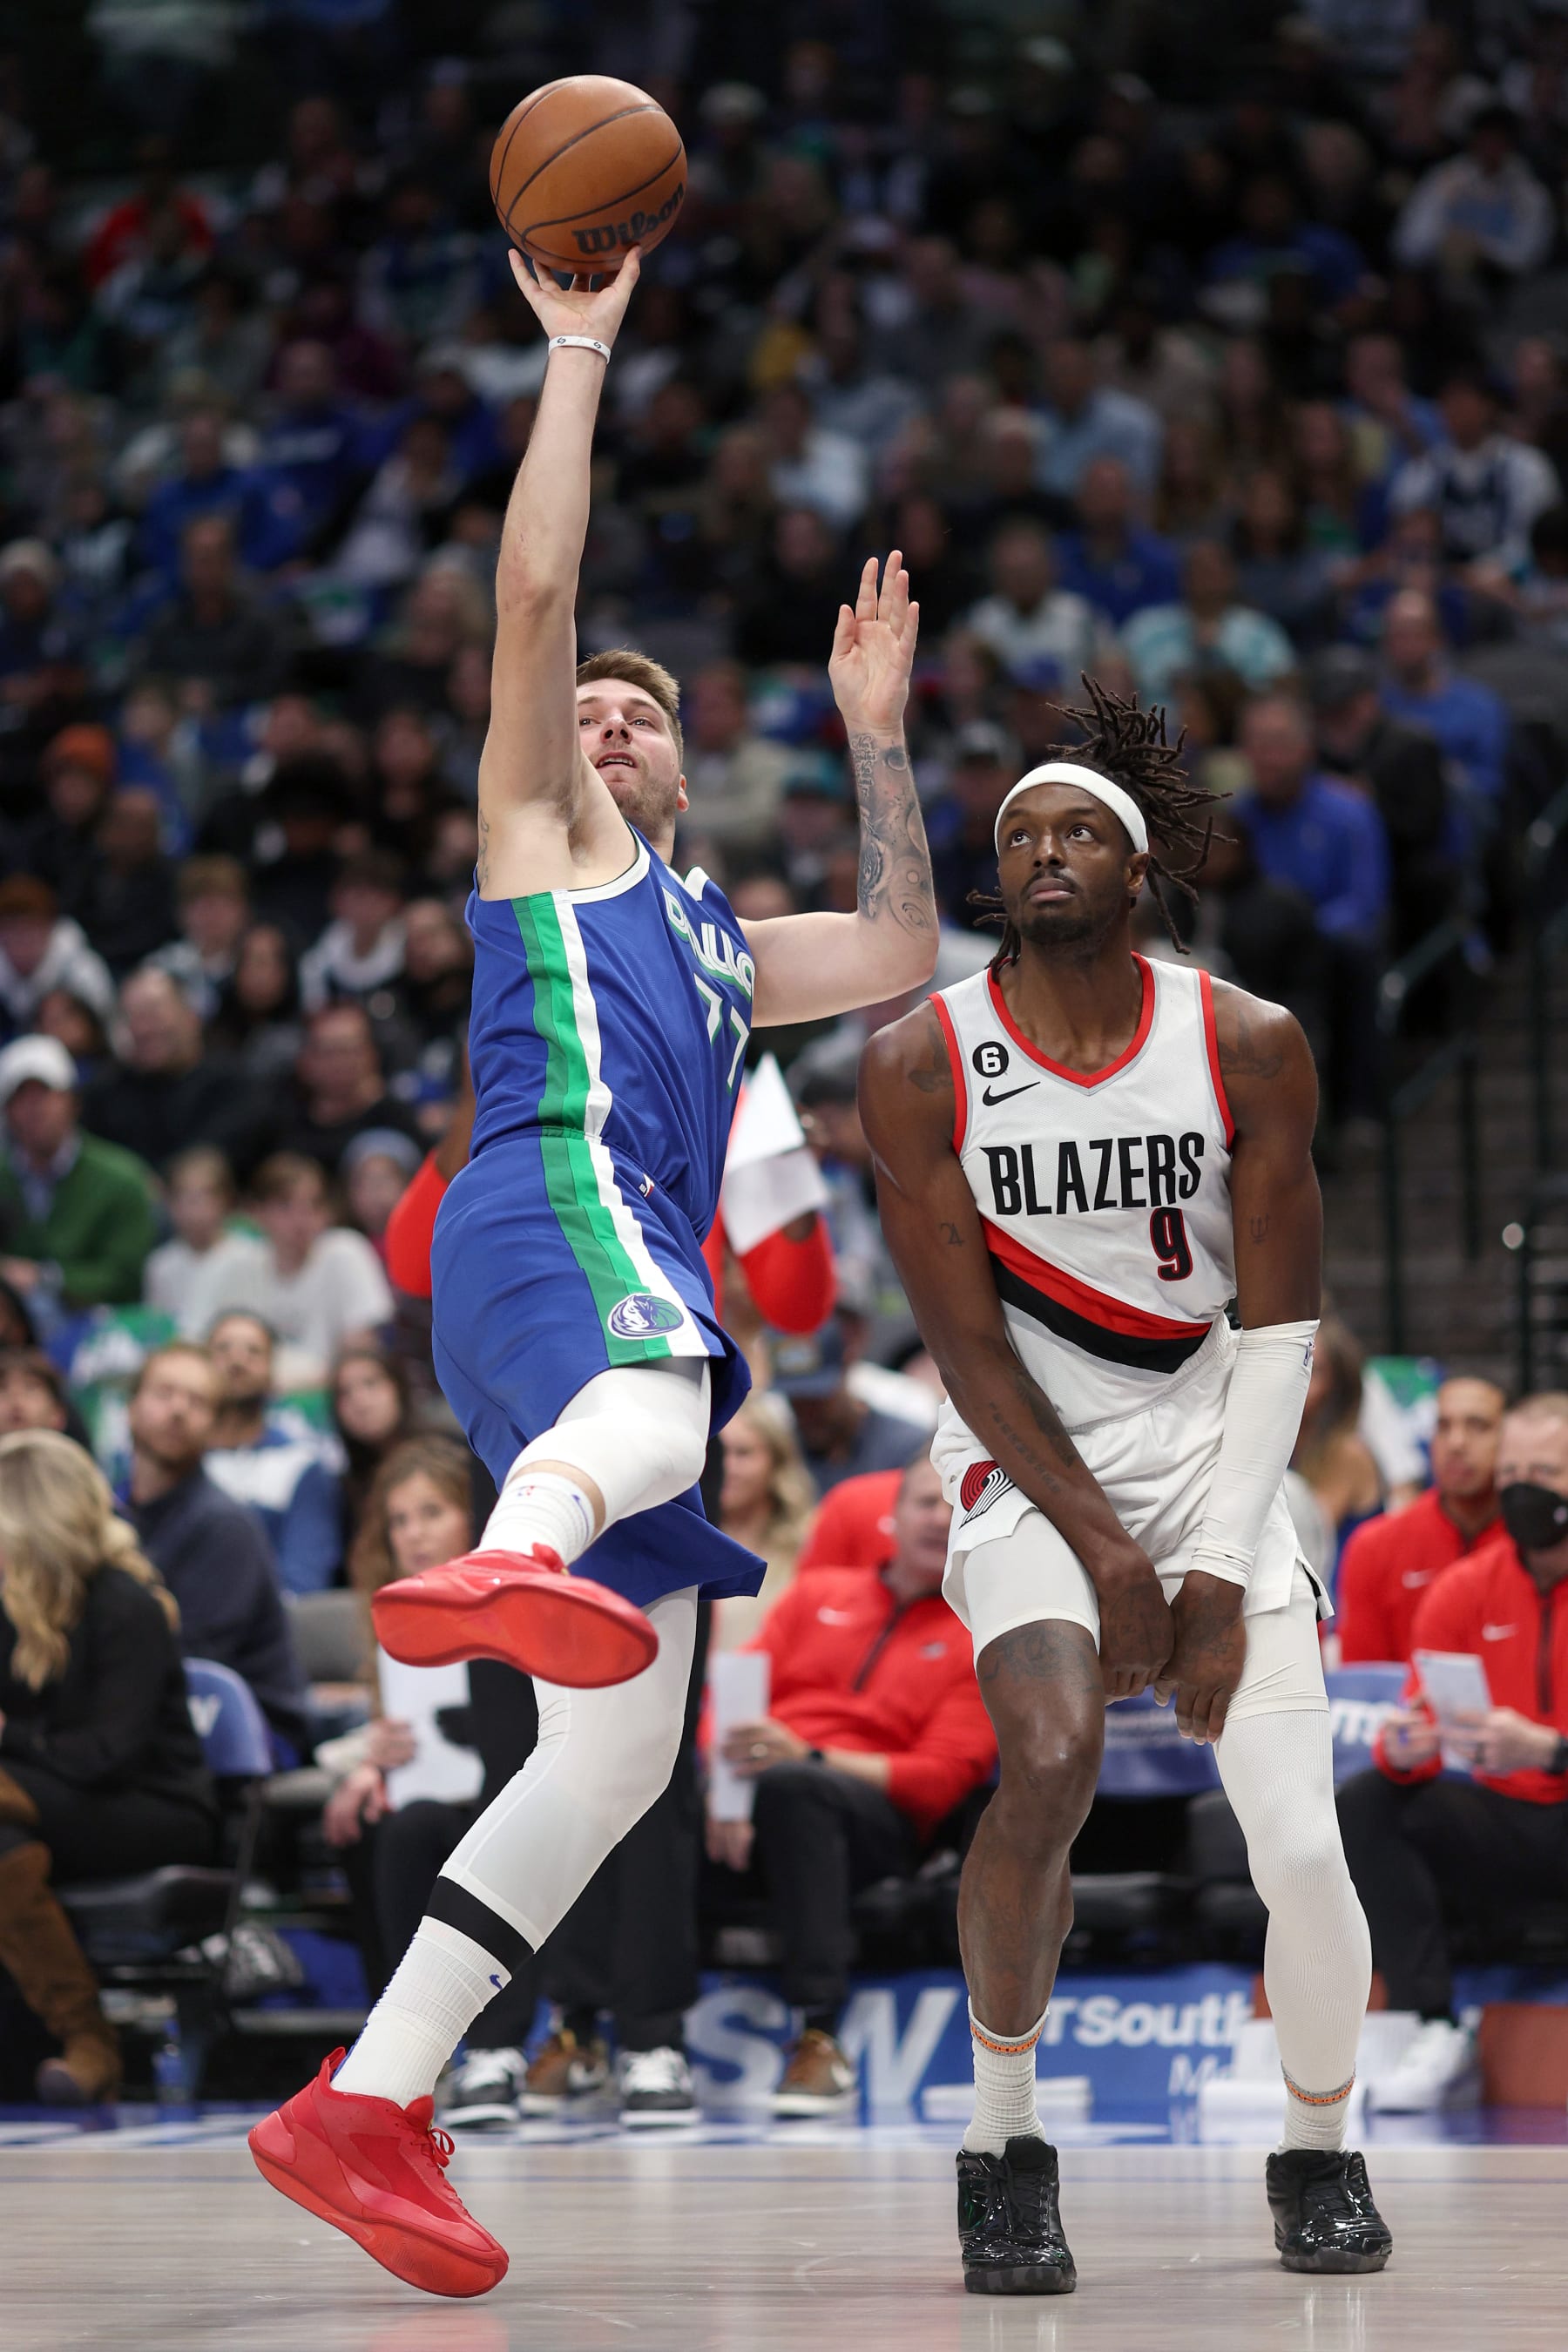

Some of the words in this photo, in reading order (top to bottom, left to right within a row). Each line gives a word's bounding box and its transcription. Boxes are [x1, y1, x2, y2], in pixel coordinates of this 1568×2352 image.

[571, 181, 684, 254] Wilson
[693, 972, 750, 1095] 77
[981, 1046, 1001, 1073] 6
[980, 1132, 1205, 1215] BLAZERS
[1150, 1206, 1193, 1281] 9
